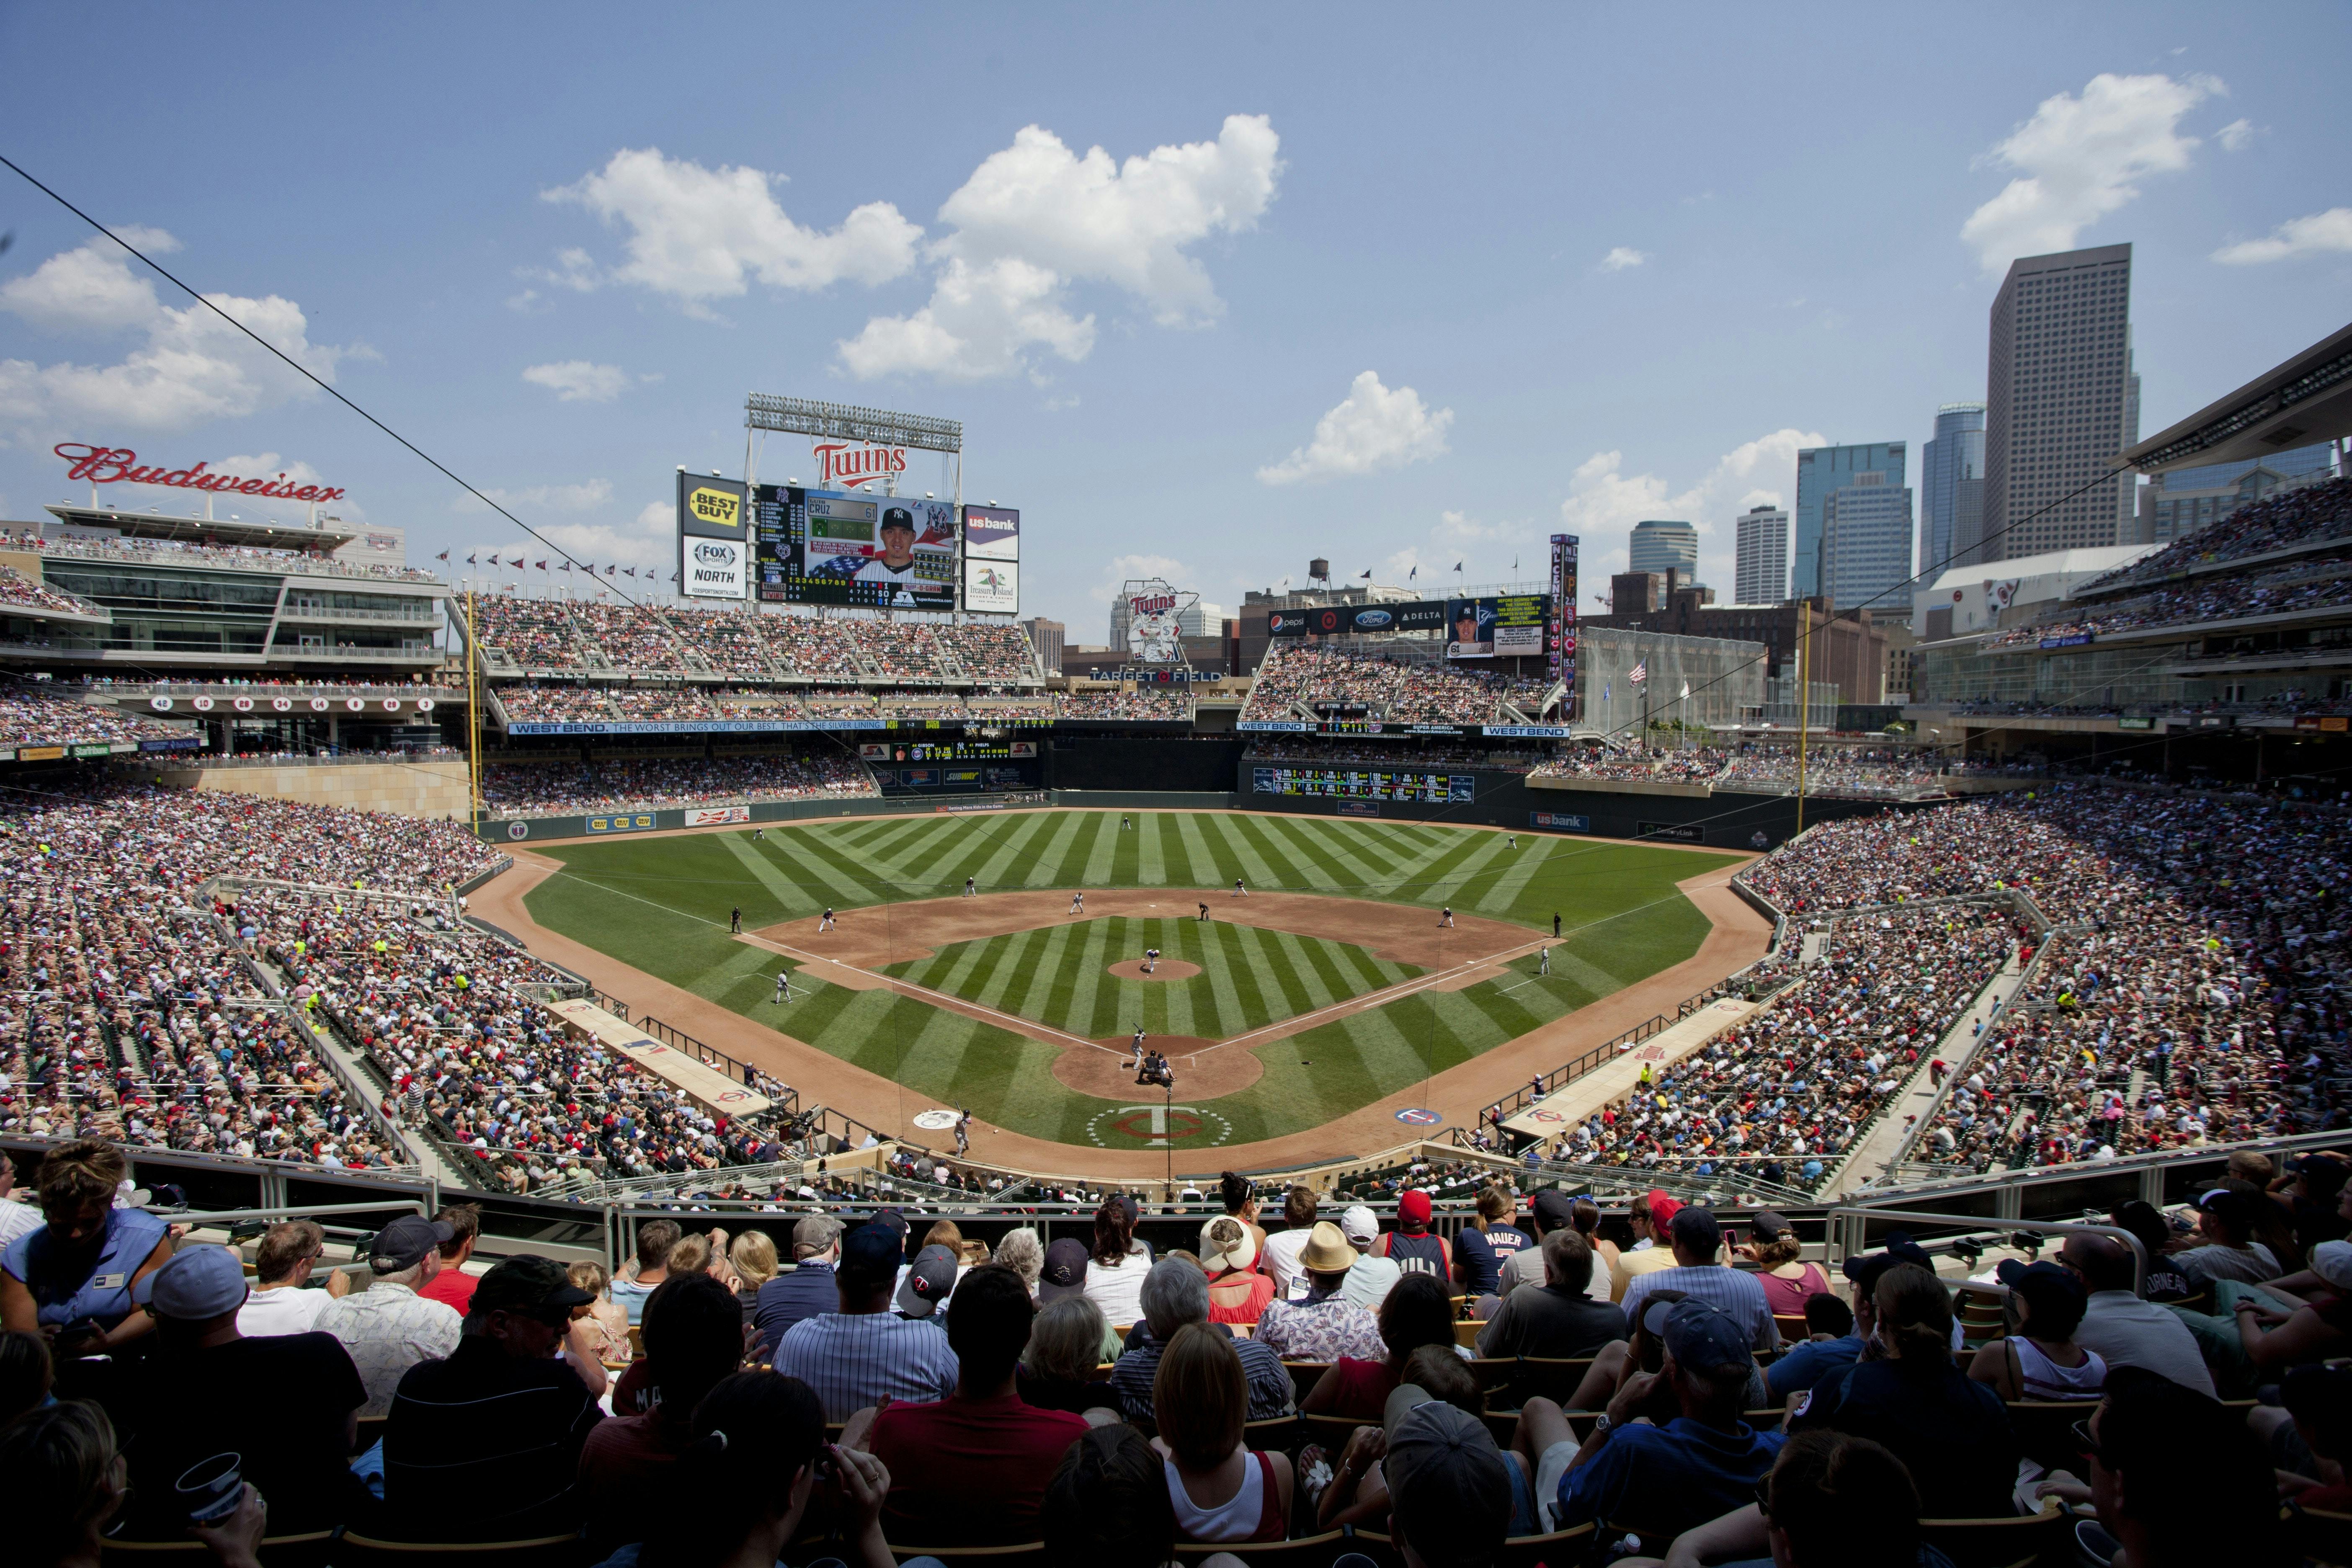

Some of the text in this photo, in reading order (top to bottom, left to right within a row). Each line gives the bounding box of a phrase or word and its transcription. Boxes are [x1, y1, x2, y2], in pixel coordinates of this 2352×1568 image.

[812, 439, 907, 483] Twins
[54, 443, 345, 503] Budweiser
[697, 493, 737, 510] BEST
[697, 505, 733, 520] BUY
[810, 504, 875, 518] CRUZ 61
[703, 546, 727, 558] FOX
[695, 569, 735, 583] NORTH
[692, 588, 738, 596] FOXSPORTSNORTH.COM
[970, 585, 1013, 596] Treasure Island
[1130, 593, 1176, 616] Twins
[1284, 619, 1304, 627] pepsi
[1363, 613, 1384, 624] Ford
[1090, 671, 1222, 682] TARGET FIELD
[200, 699, 208, 707] 10
[1489, 727, 1564, 736] WEST BEND
[947, 772, 979, 781] SUBWAY
[1485, 1232, 1521, 1247] MAUER
